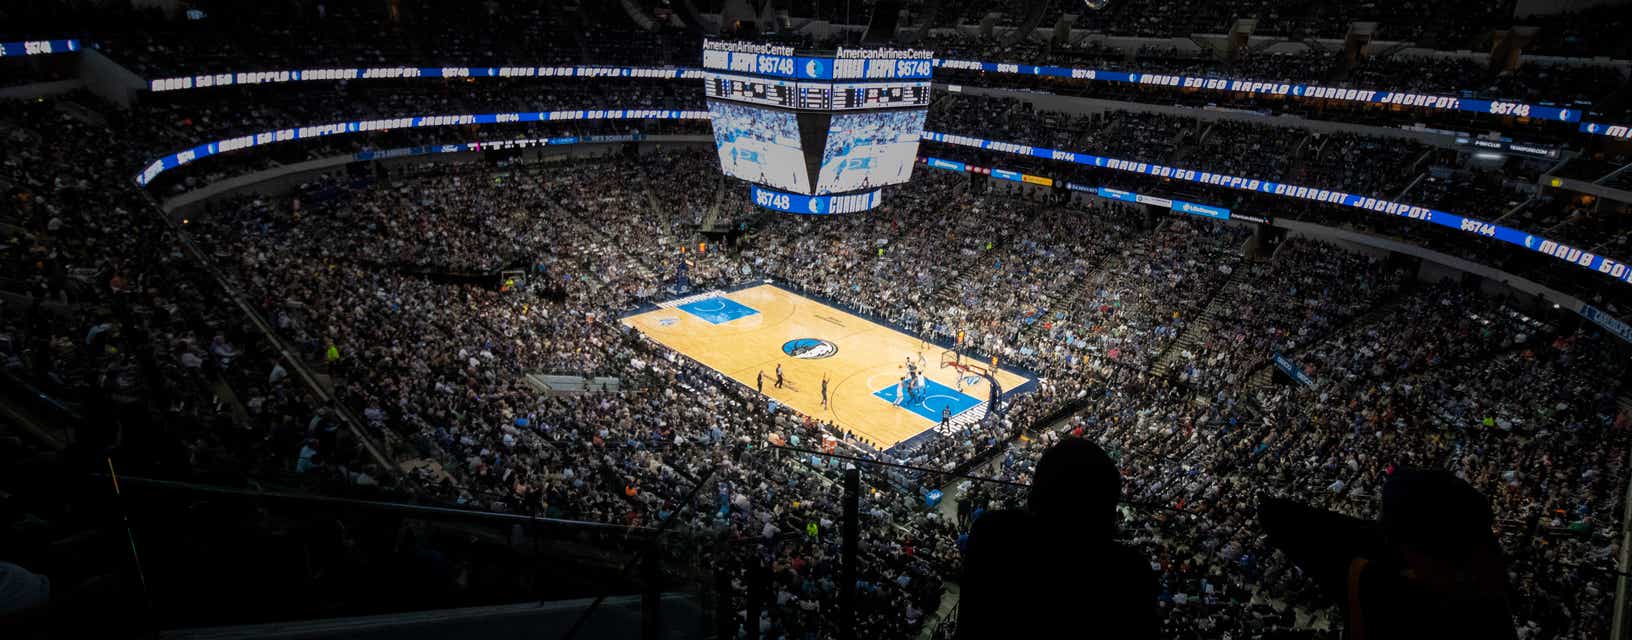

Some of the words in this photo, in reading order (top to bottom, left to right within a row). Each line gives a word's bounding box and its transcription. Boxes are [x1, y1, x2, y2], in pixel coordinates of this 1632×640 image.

[758, 55, 795, 75] $6748
[897, 60, 931, 77] $6748
[1380, 92, 1460, 109] JACKPOT:
[1490, 100, 1530, 117] $6748
[756, 188, 791, 211] $6748
[1352, 197, 1432, 221] JACKPOT:
[1461, 218, 1496, 237] $6744
